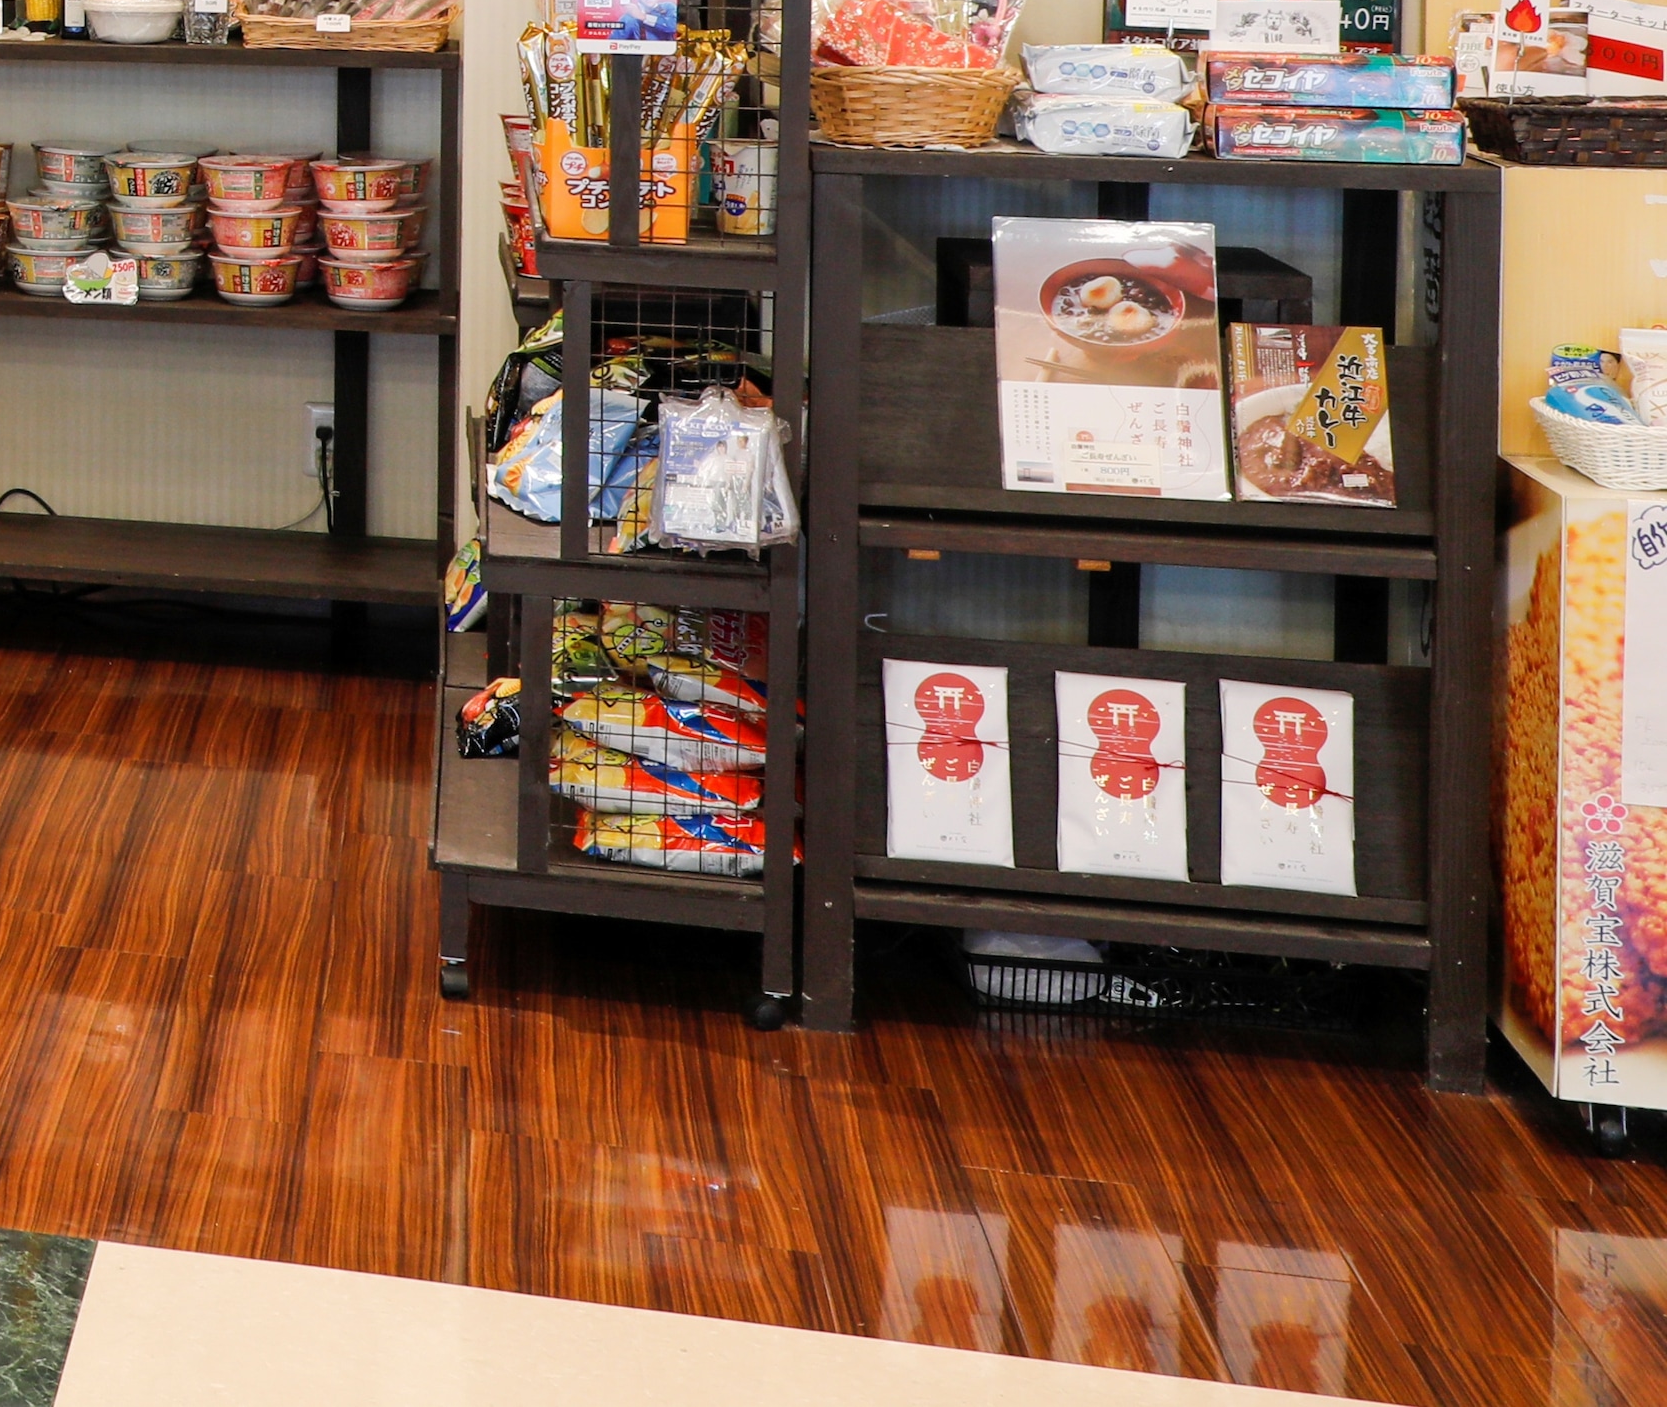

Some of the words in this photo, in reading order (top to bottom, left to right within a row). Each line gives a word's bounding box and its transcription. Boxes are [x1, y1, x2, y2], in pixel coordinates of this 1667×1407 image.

[1338, 8, 1390, 31] 40円
[1223, 66, 1328, 92] メタセコイヤ
[1495, 83, 1536, 96] 使い方
[549, 83, 562, 119] コンソ
[1232, 122, 1339, 148] メタセコイヤ
[565, 178, 676, 199] プチテト
[111, 261, 136, 273] 250円
[1336, 354, 1367, 428] 近江牛
[1126, 401, 1144, 446] ぜんざ
[1152, 402, 1168, 450] ご長寿
[1314, 387, 1340, 448] カレー
[1080, 452, 1138, 462] ご長寿ぜんざい
[1099, 466, 1130, 476] 800円
[773, 521, 784, 529] M
[1580, 840, 1626, 1088] 滋賀宝株式会社
